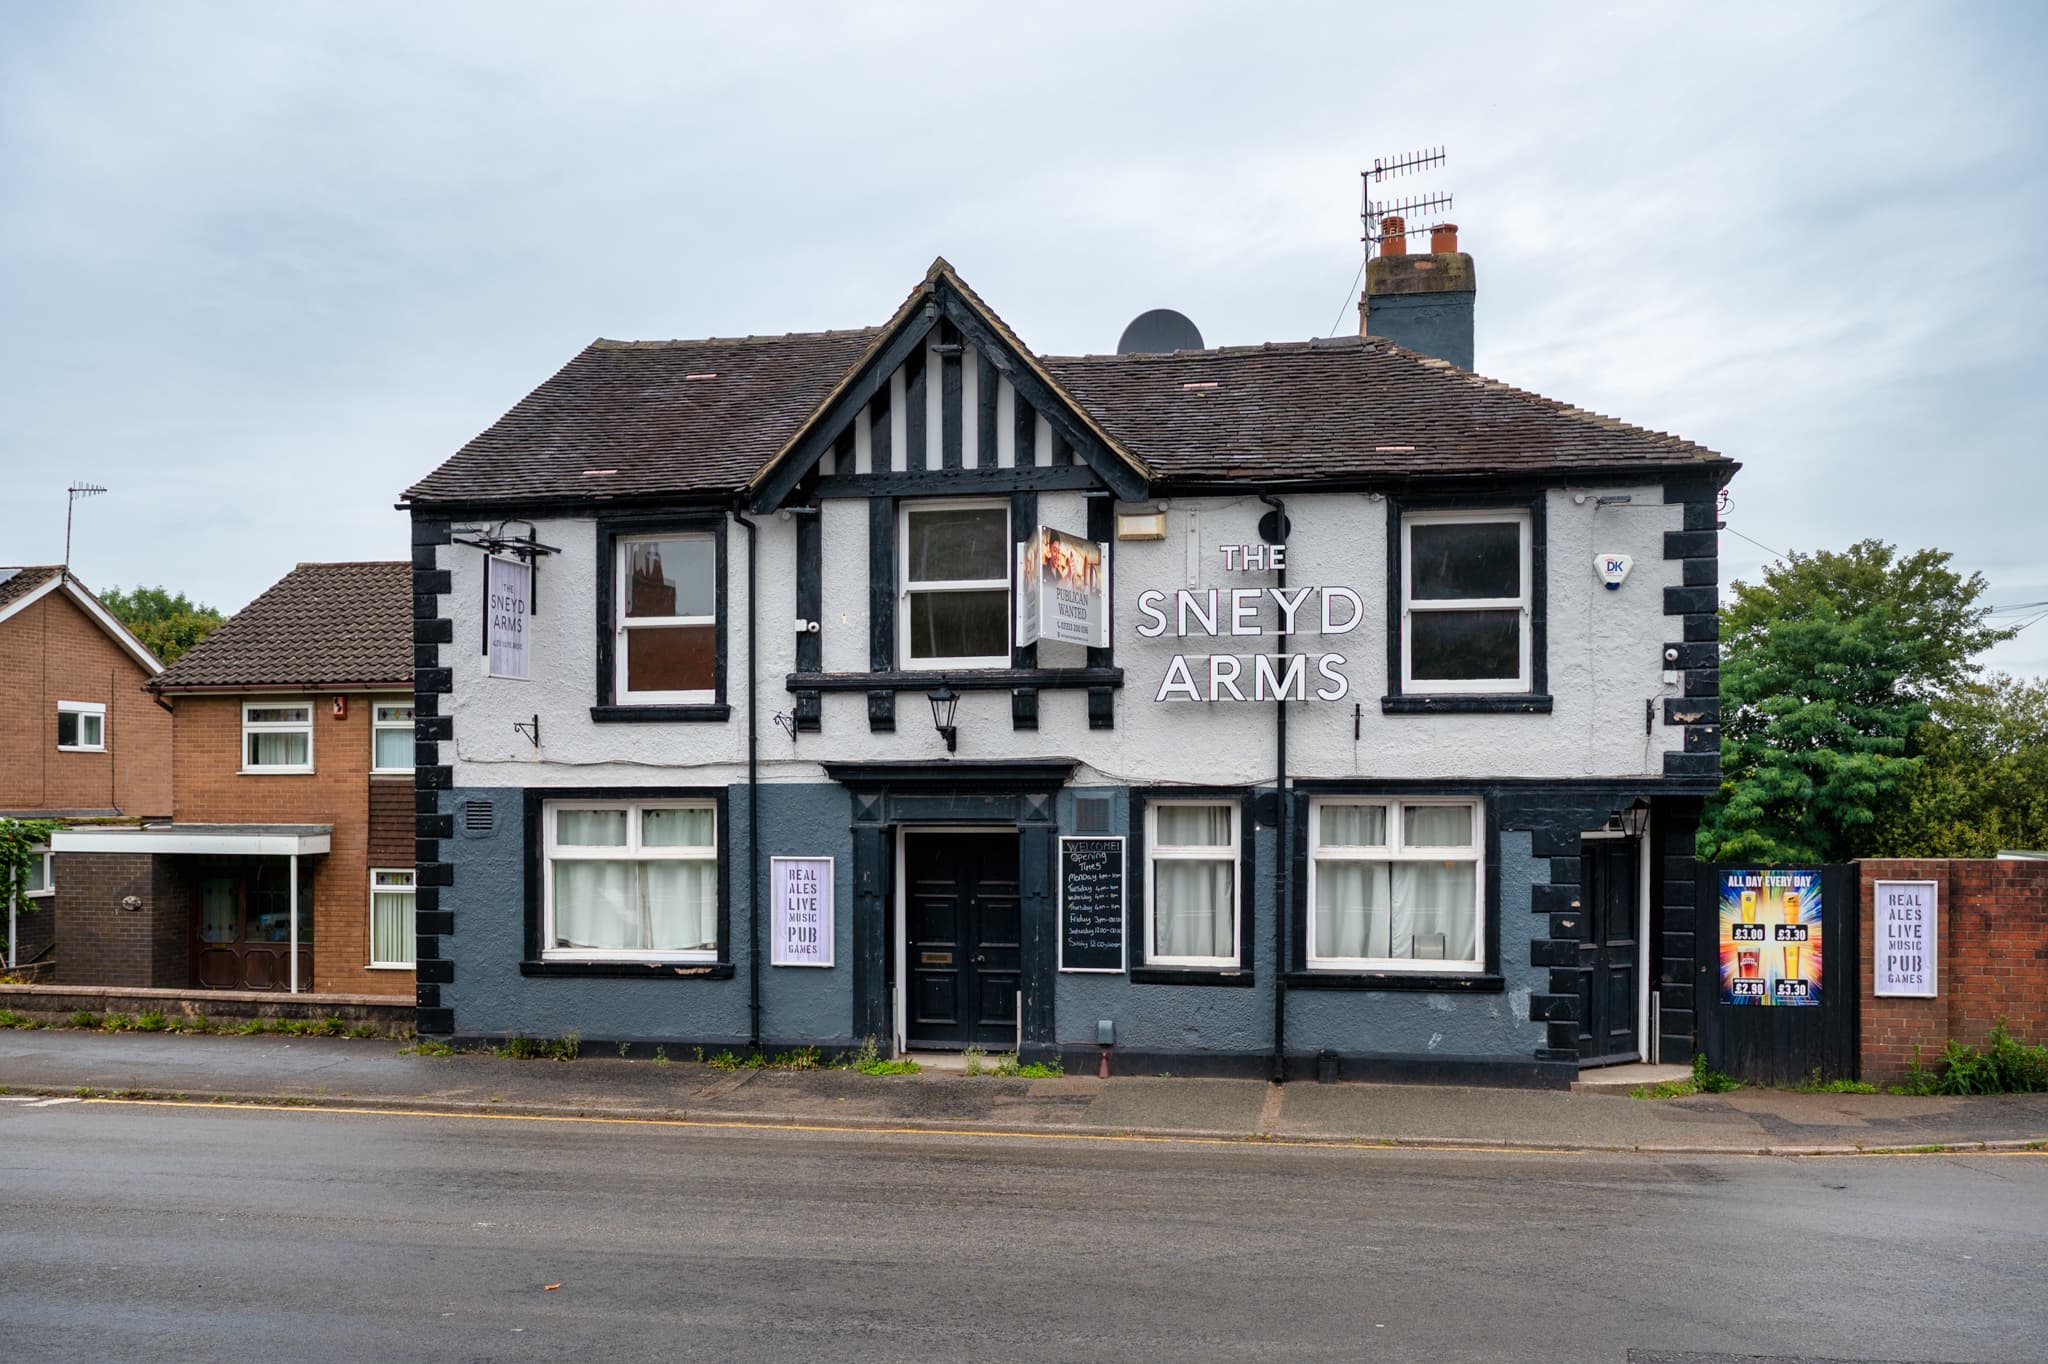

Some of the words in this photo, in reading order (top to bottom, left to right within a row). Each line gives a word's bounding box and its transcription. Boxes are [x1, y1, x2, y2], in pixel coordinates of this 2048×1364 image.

[1220, 544, 1287, 571] THE
[1606, 561, 1623, 572] DK
[504, 584, 514, 593] THE
[1056, 587, 1089, 606] PUBLICAN
[490, 594, 525, 615] SNEYD
[1058, 602, 1087, 620] WANTED
[1135, 586, 1365, 638] SNEYD
[493, 614, 522, 633] ARMS
[1154, 653, 1350, 702] ARMS
[789, 869, 817, 880] REAL
[1727, 876, 1744, 887] ALL
[1745, 876, 1762, 887] DAY
[1765, 876, 1793, 887] EVERY
[1794, 876, 1812, 887] DAY
[789, 883, 817, 894] ALES
[788, 898, 817, 910] LIVE
[1888, 894, 1922, 906] REAL
[788, 913, 817, 923] MUSIC
[1889, 909, 1922, 920] ALES
[788, 926, 817, 943] PUB
[1734, 930, 1763, 940] £3.00
[1777, 930, 1806, 941] £3.30
[1888, 924, 1922, 938] LIVE
[788, 944, 818, 954] GAMES
[1888, 940, 1922, 951] MUSIC
[1887, 955, 1922, 972] PUB
[1888, 974, 1923, 984] GAMES
[1735, 984, 1764, 995] £2.90
[1777, 985, 1806, 996] £3.30
